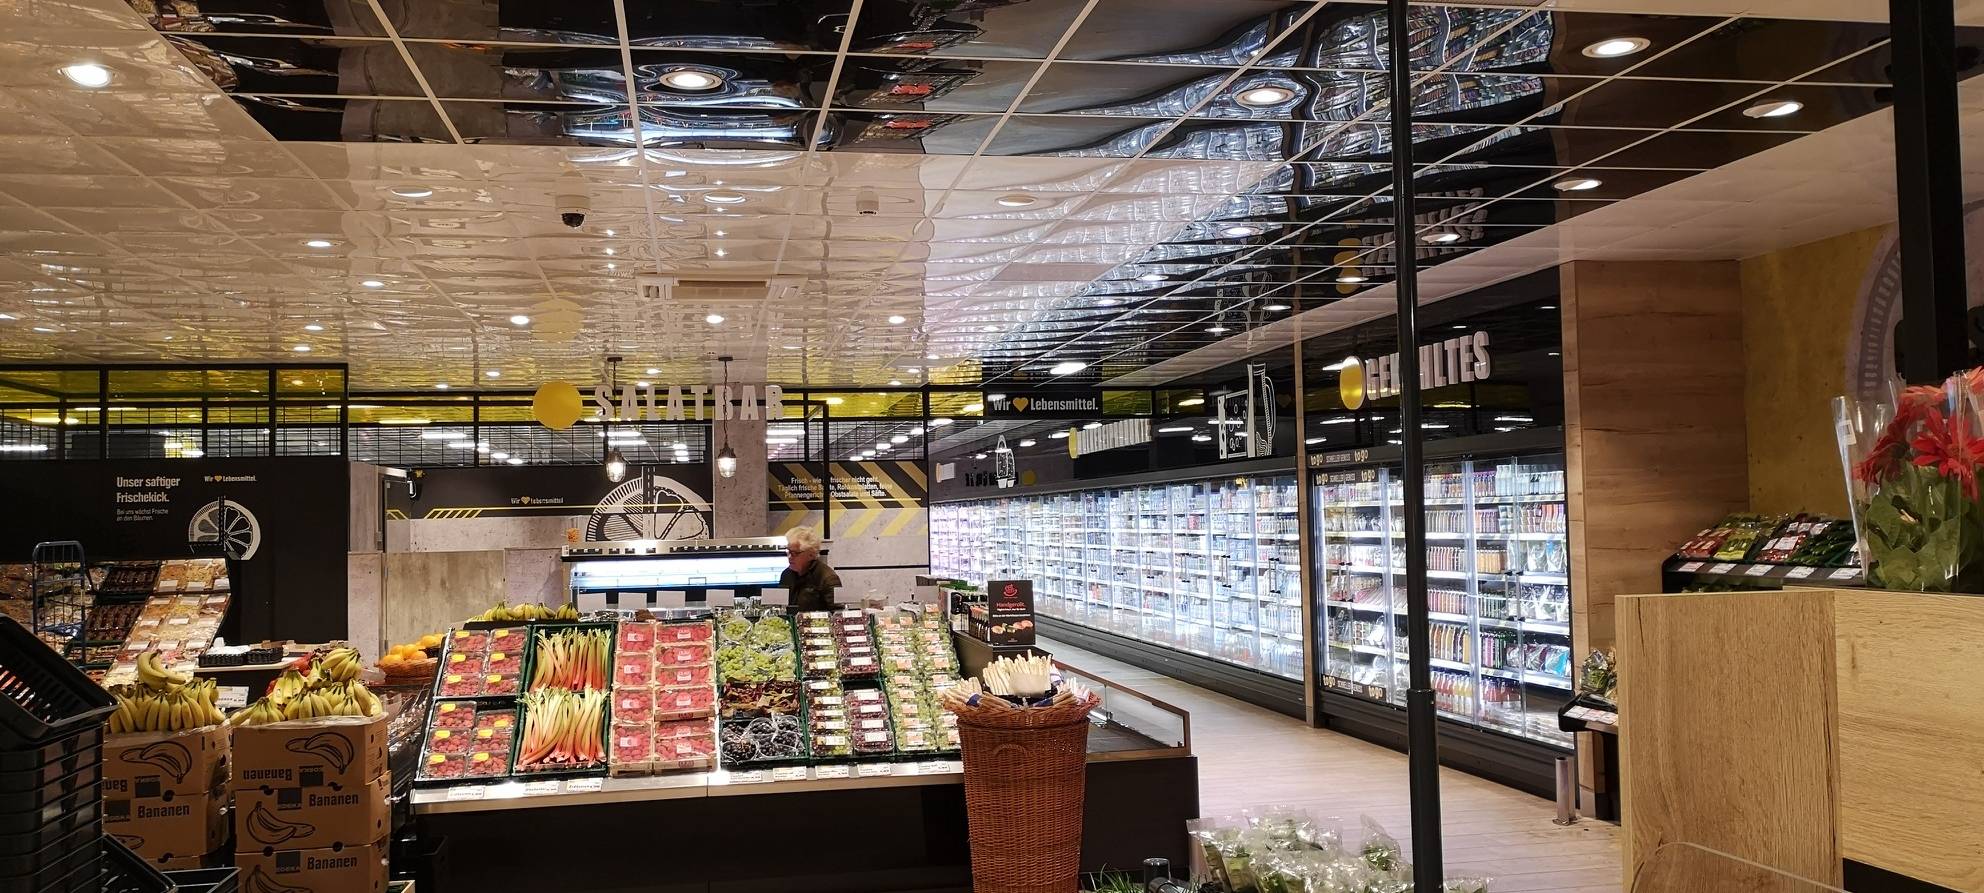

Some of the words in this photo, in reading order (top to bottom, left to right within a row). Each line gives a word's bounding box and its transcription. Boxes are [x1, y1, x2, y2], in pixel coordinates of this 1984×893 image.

[1366, 331, 1491, 400] GEKHLTES
[594, 385, 784, 421] SALATBAR
[993, 397, 1011, 411] Wir
[1030, 397, 1099, 411] Lebensmittel.
[116, 476, 143, 488] Unser
[145, 476, 180, 489] saftiger
[116, 491, 170, 503] Frischekick.
[243, 768, 292, 781] Bananen
[309, 794, 359, 807] Bananen
[137, 805, 190, 818] Bananen
[307, 856, 358, 870] Bananen
